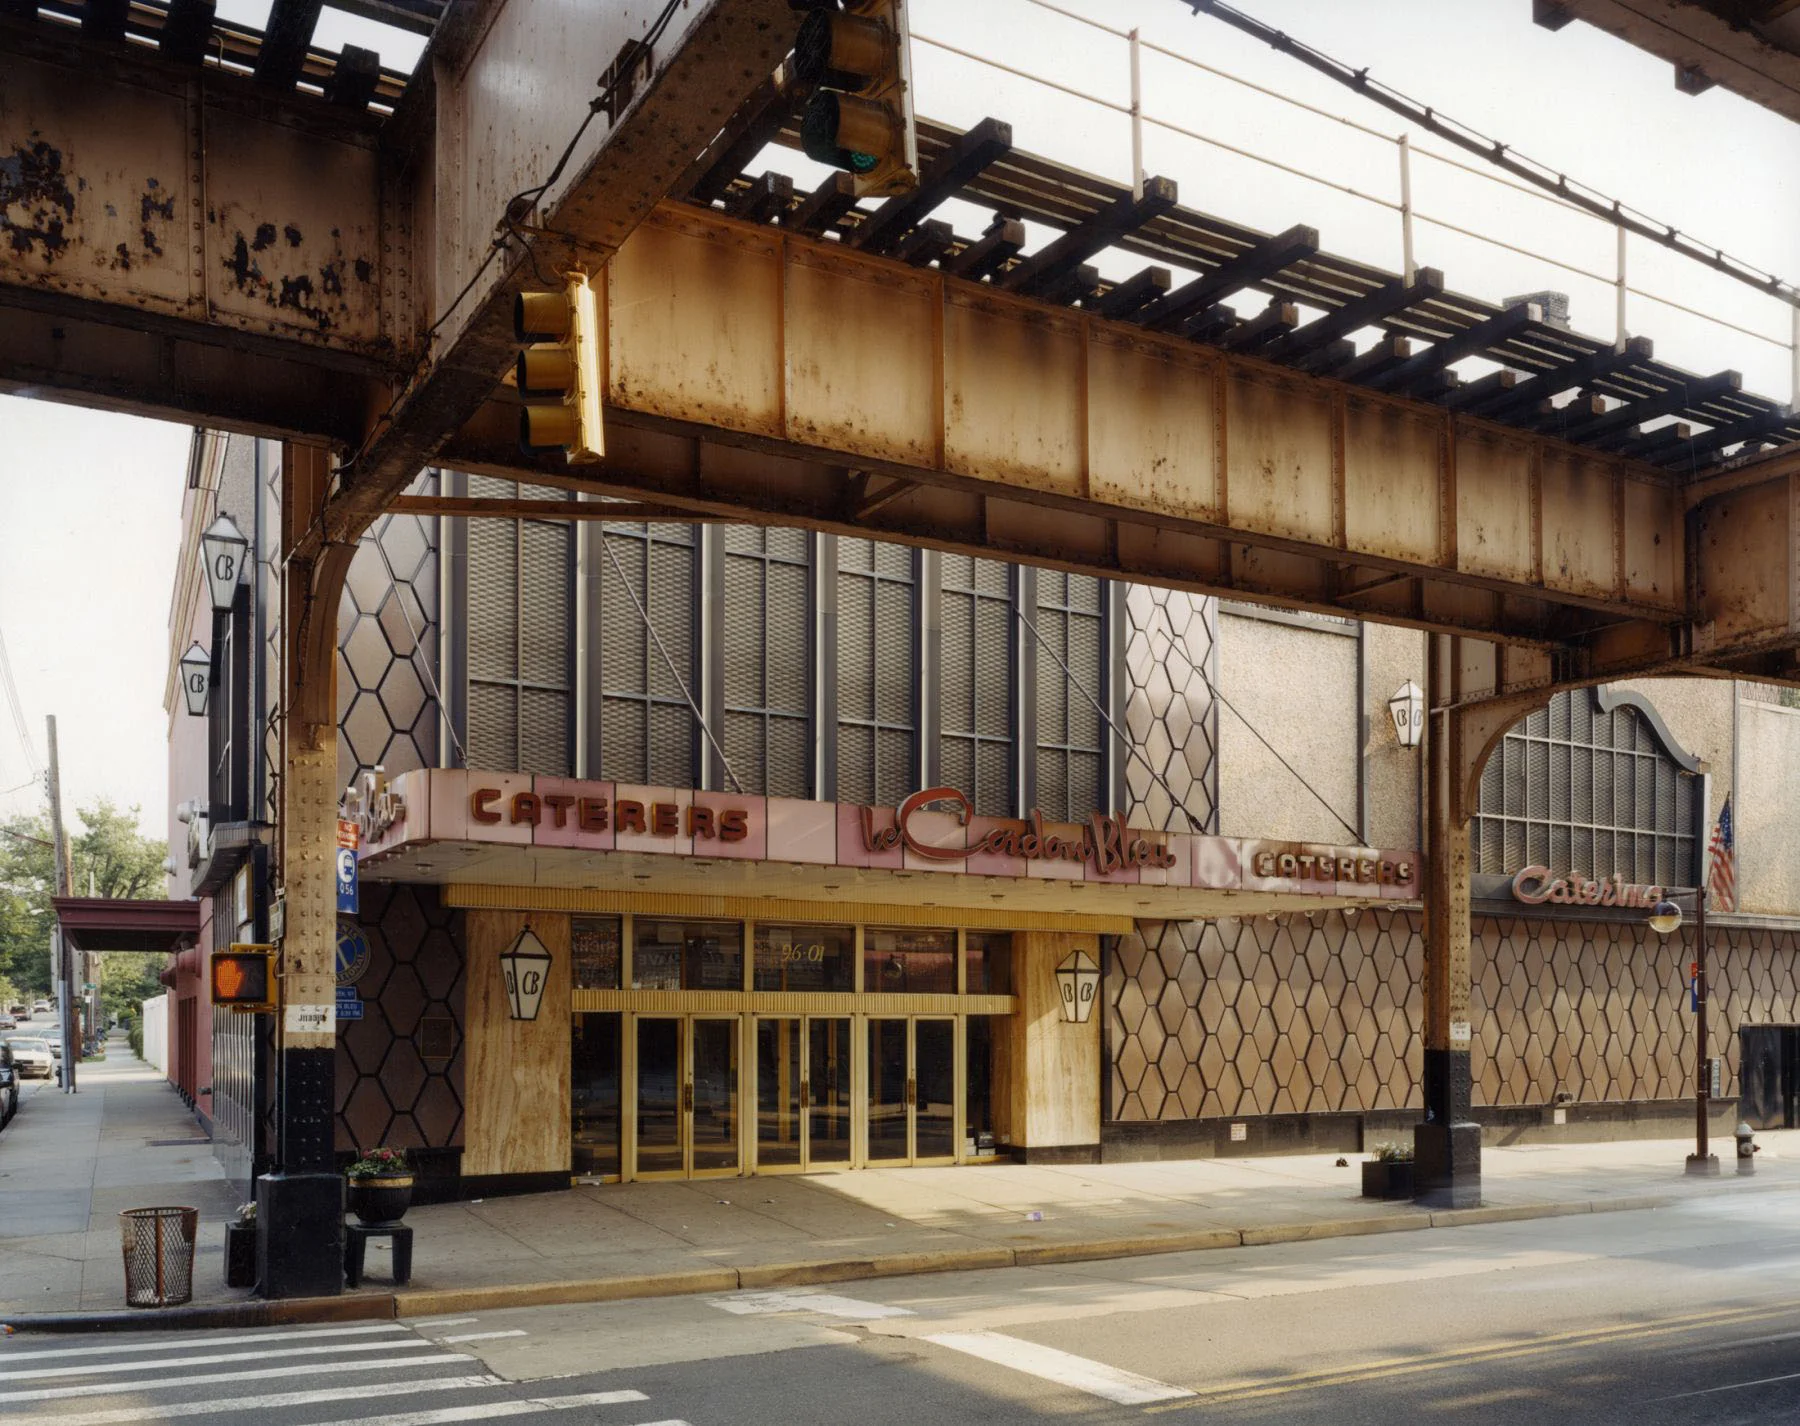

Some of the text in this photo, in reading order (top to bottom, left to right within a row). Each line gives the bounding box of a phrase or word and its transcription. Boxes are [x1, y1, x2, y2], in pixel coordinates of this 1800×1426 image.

[215, 554, 234, 581] CB
[189, 673, 205, 693] CB
[471, 788, 748, 842] CATERERS
[896, 787, 1096, 861] Cordon
[1086, 809, 1177, 875] Bleu
[522, 971, 540, 995] CB
